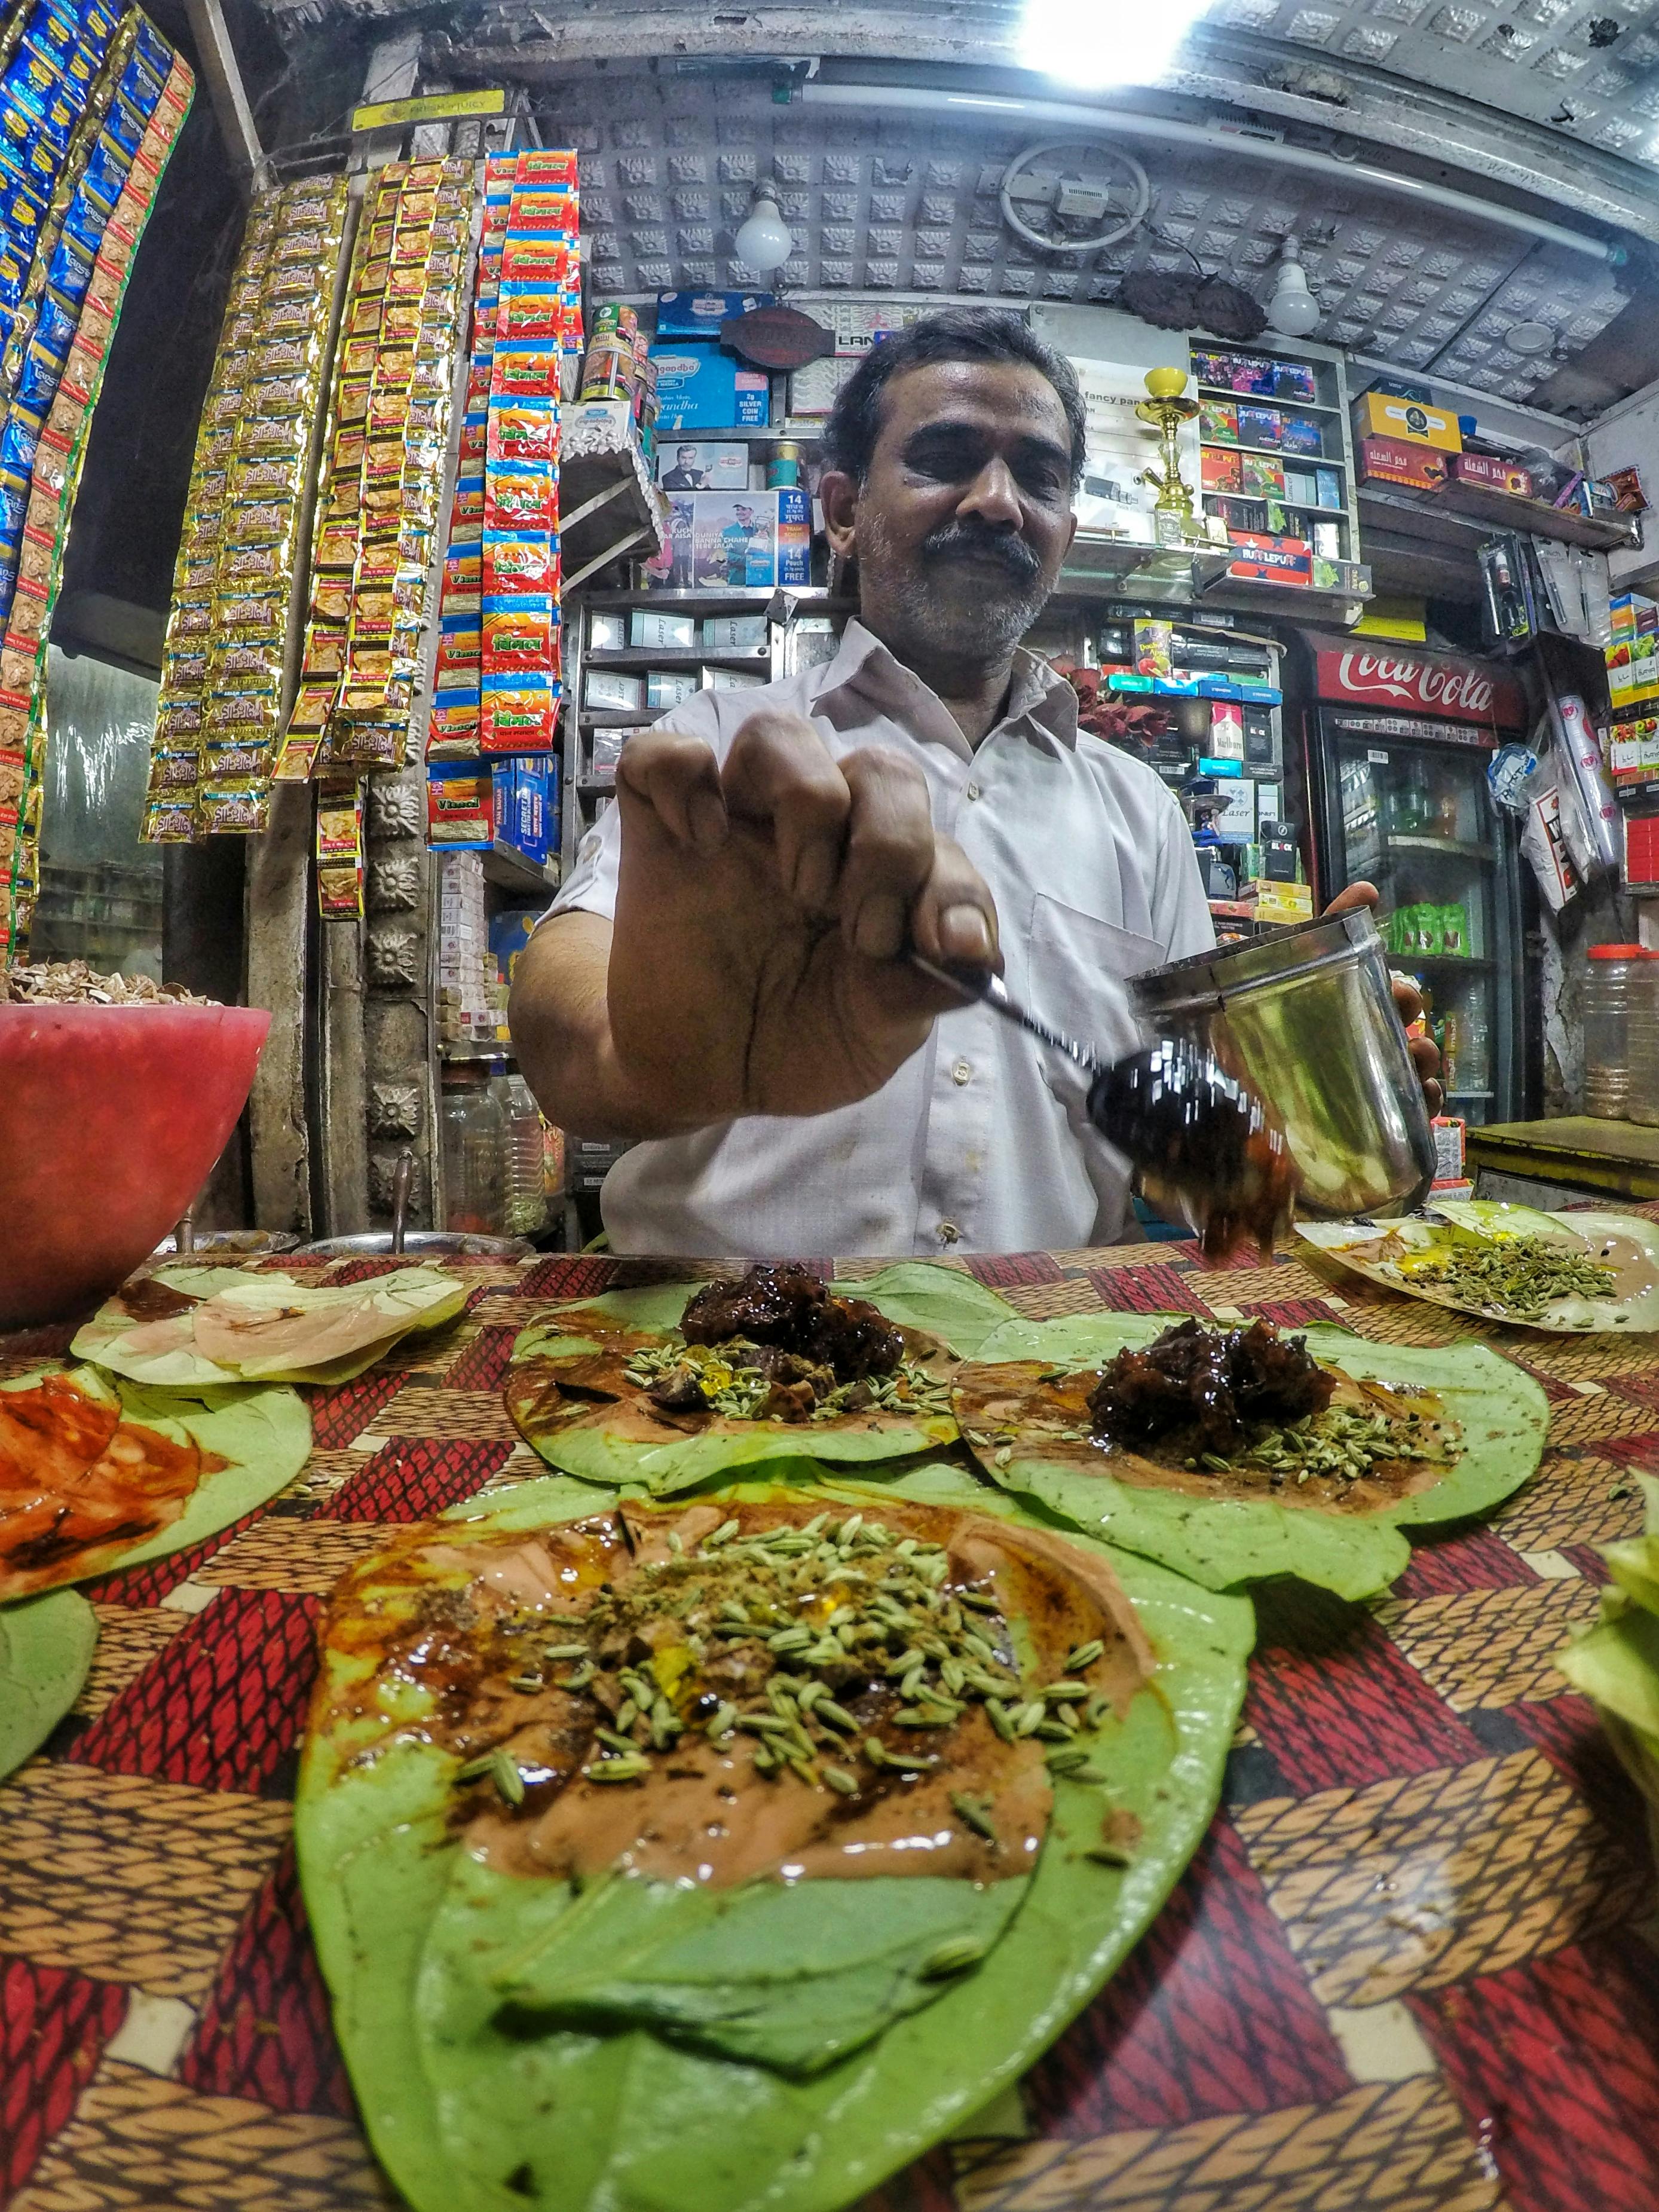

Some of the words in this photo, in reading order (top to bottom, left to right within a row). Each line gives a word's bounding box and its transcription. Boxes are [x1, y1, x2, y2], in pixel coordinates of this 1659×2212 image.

[838, 336, 874, 345] LAN
[657, 363, 695, 374] igandha
[1084, 391, 1116, 405] fancy
[788, 495, 802, 504] 14
[788, 548, 802, 559] 14
[784, 573, 804, 581] FREE
[658, 617, 666, 645] Laser
[729, 620, 739, 647] Laser
[492, 634, 543, 651] विमल
[492, 709, 543, 728] विमल
[1222, 808, 1250, 818] Laser
